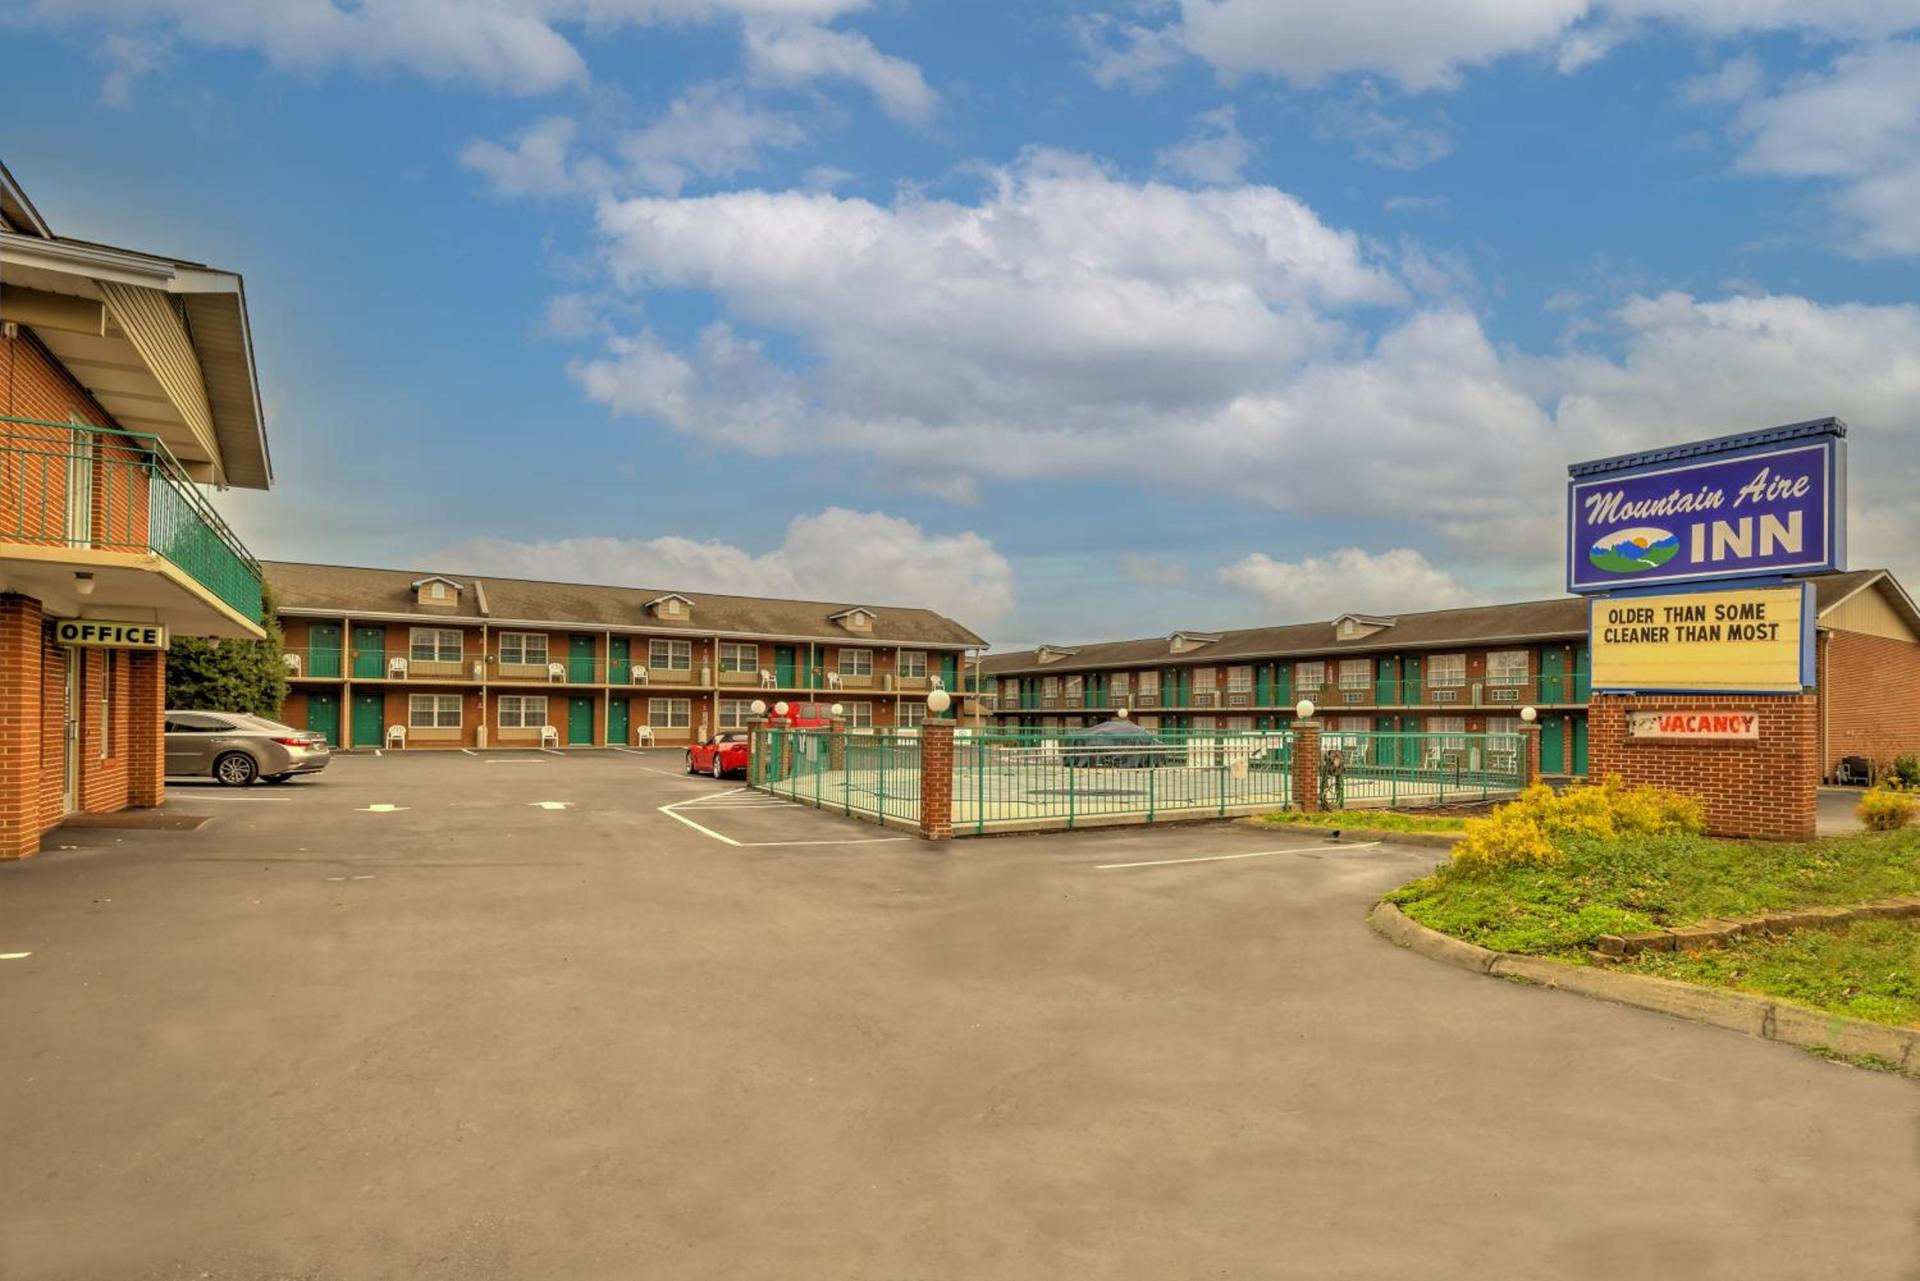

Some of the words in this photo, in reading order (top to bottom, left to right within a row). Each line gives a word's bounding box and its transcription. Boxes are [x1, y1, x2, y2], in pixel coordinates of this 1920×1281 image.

[1585, 485, 1724, 525] Mountain
[1733, 467, 1811, 507] Aire
[1690, 510, 1803, 563] INN
[1608, 608, 1654, 624] OLDER
[1664, 605, 1706, 623] THAN
[1715, 603, 1765, 621] SOME
[60, 623, 156, 644] OFFICE
[1604, 626, 1669, 643] CLEANER
[1675, 624, 1721, 642] THAN
[1727, 623, 1779, 641] MOST
[1658, 715, 1754, 733] VACANCY
